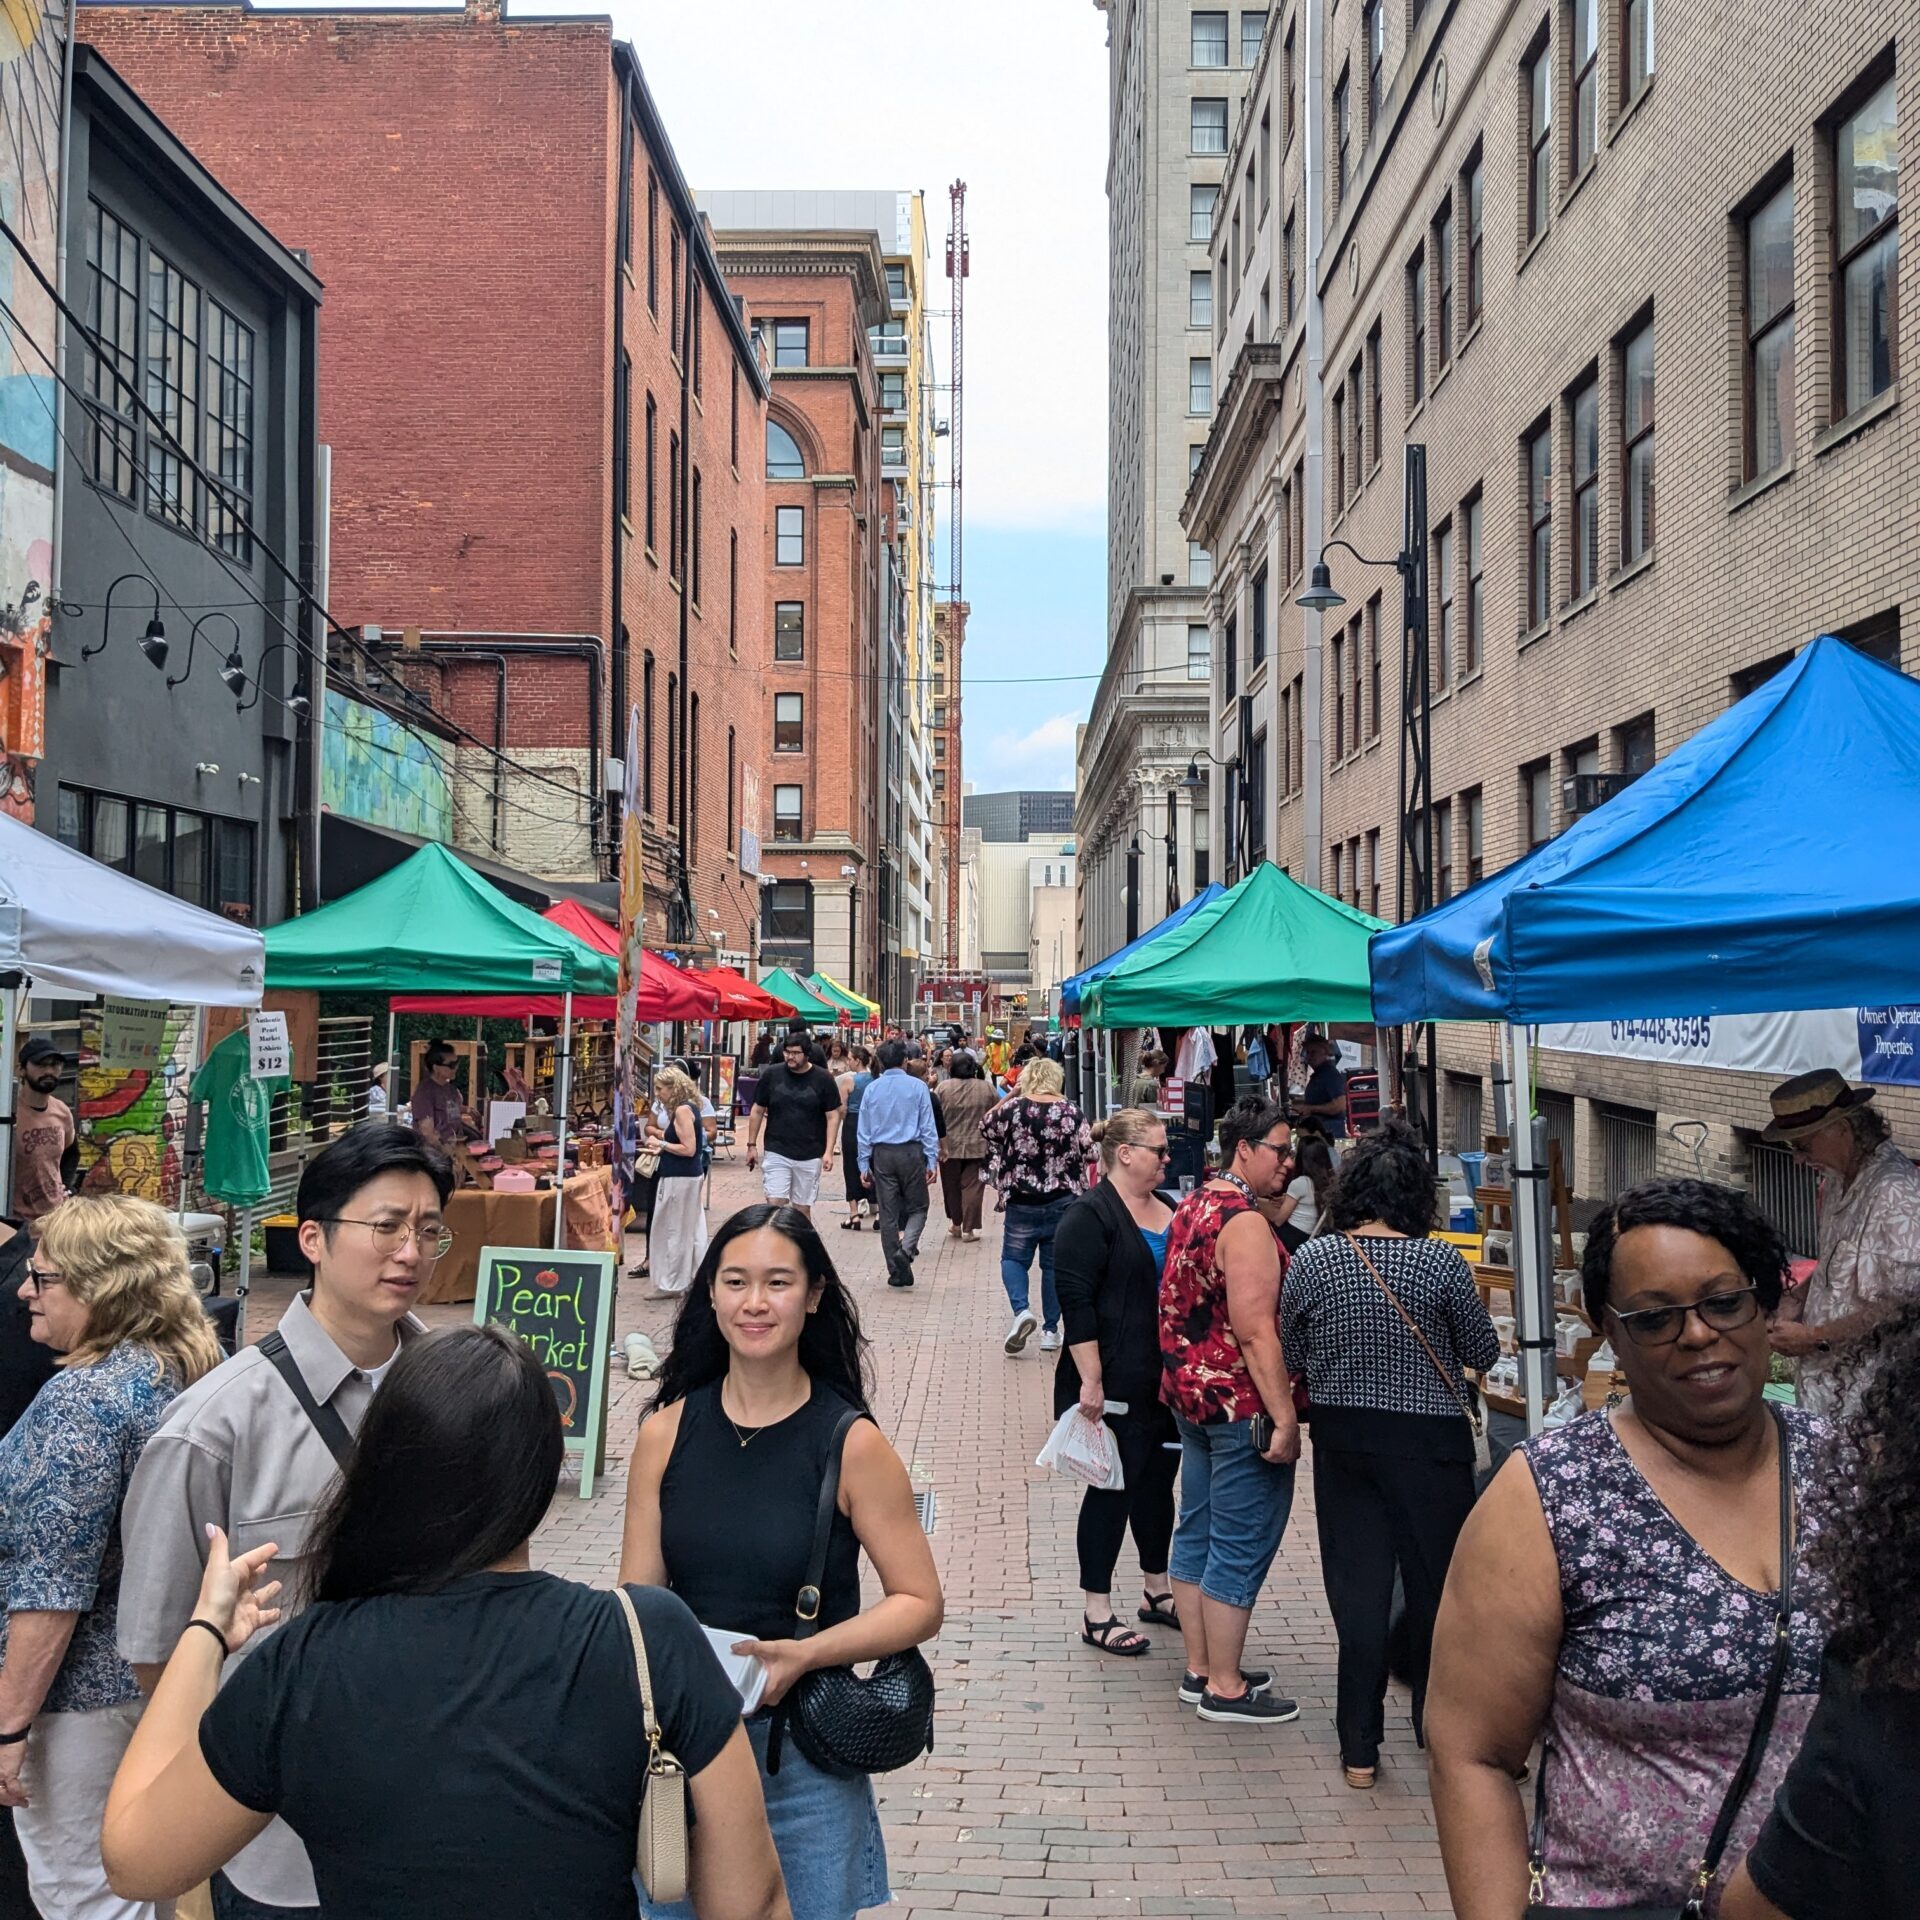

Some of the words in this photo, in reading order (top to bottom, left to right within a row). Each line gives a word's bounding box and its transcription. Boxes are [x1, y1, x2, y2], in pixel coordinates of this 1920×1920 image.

[106, 1004, 149, 1018] INFORMATION
[150, 1010, 167, 1020] TENT
[1859, 1006, 1887, 1024] Owner
[1611, 1015, 1711, 1048] 614-448-3595
[1874, 1034, 1914, 1059] Properties
[258, 1057, 282, 1070] $12
[495, 1264, 586, 1325] Pearl
